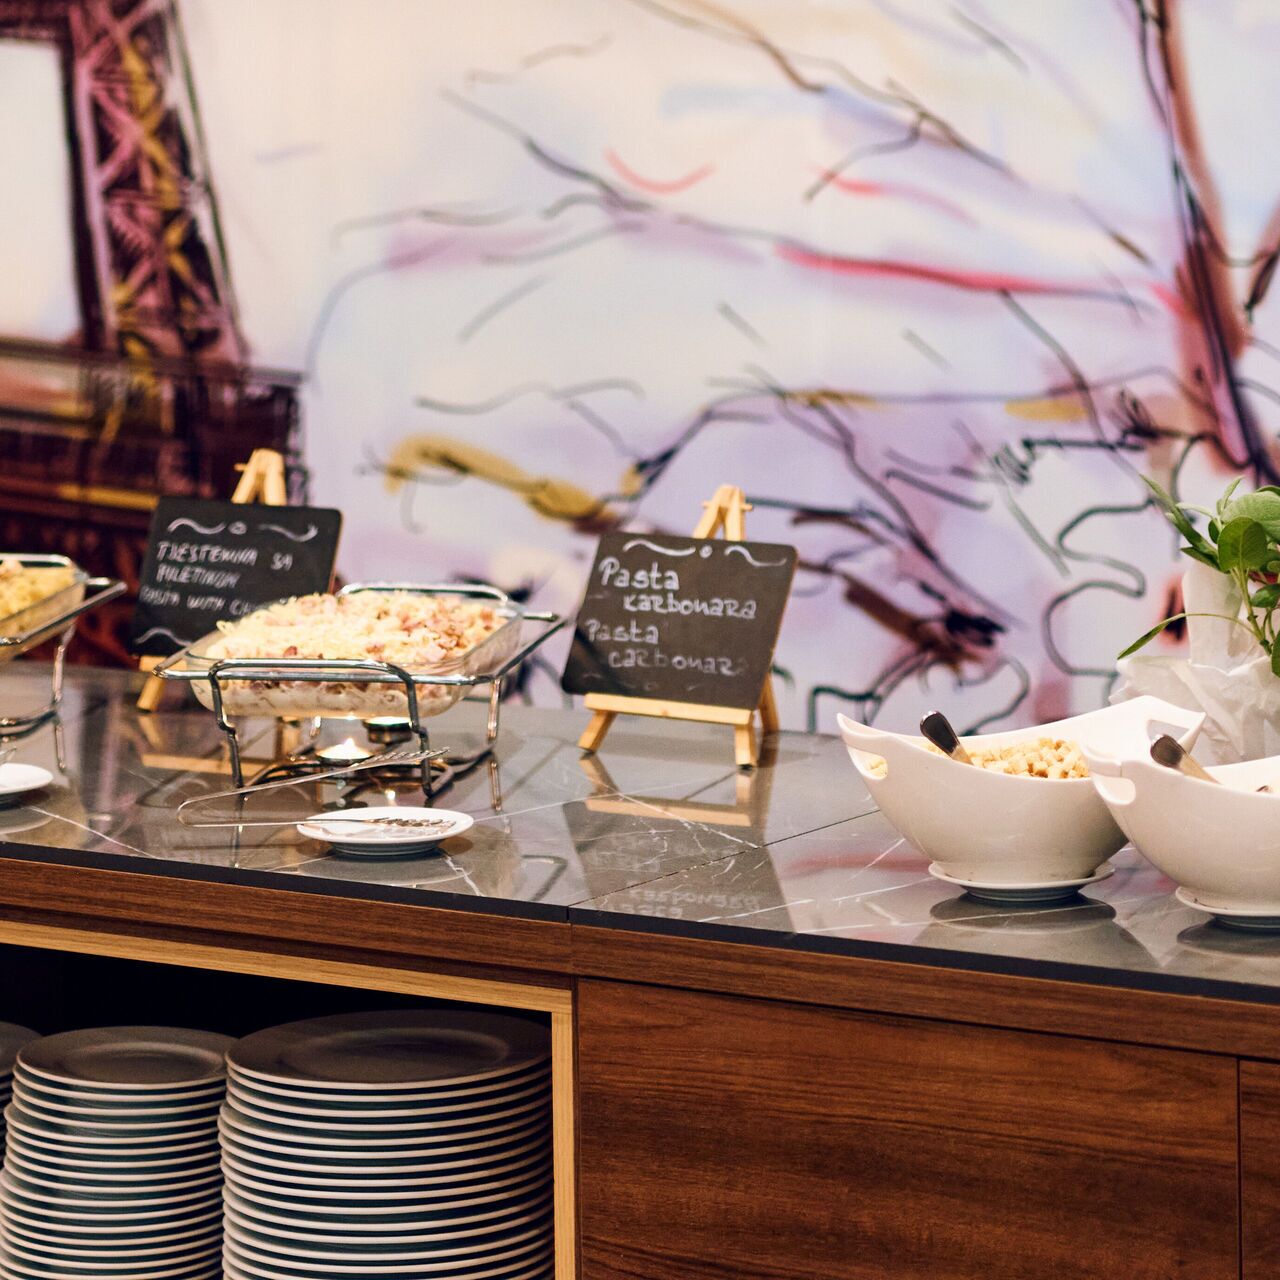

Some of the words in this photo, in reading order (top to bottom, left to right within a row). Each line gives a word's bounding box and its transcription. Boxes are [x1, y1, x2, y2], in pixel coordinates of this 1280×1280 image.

[271, 553, 293, 571] SA
[599, 556, 680, 590] Pasta
[585, 618, 659, 644] Pasta
